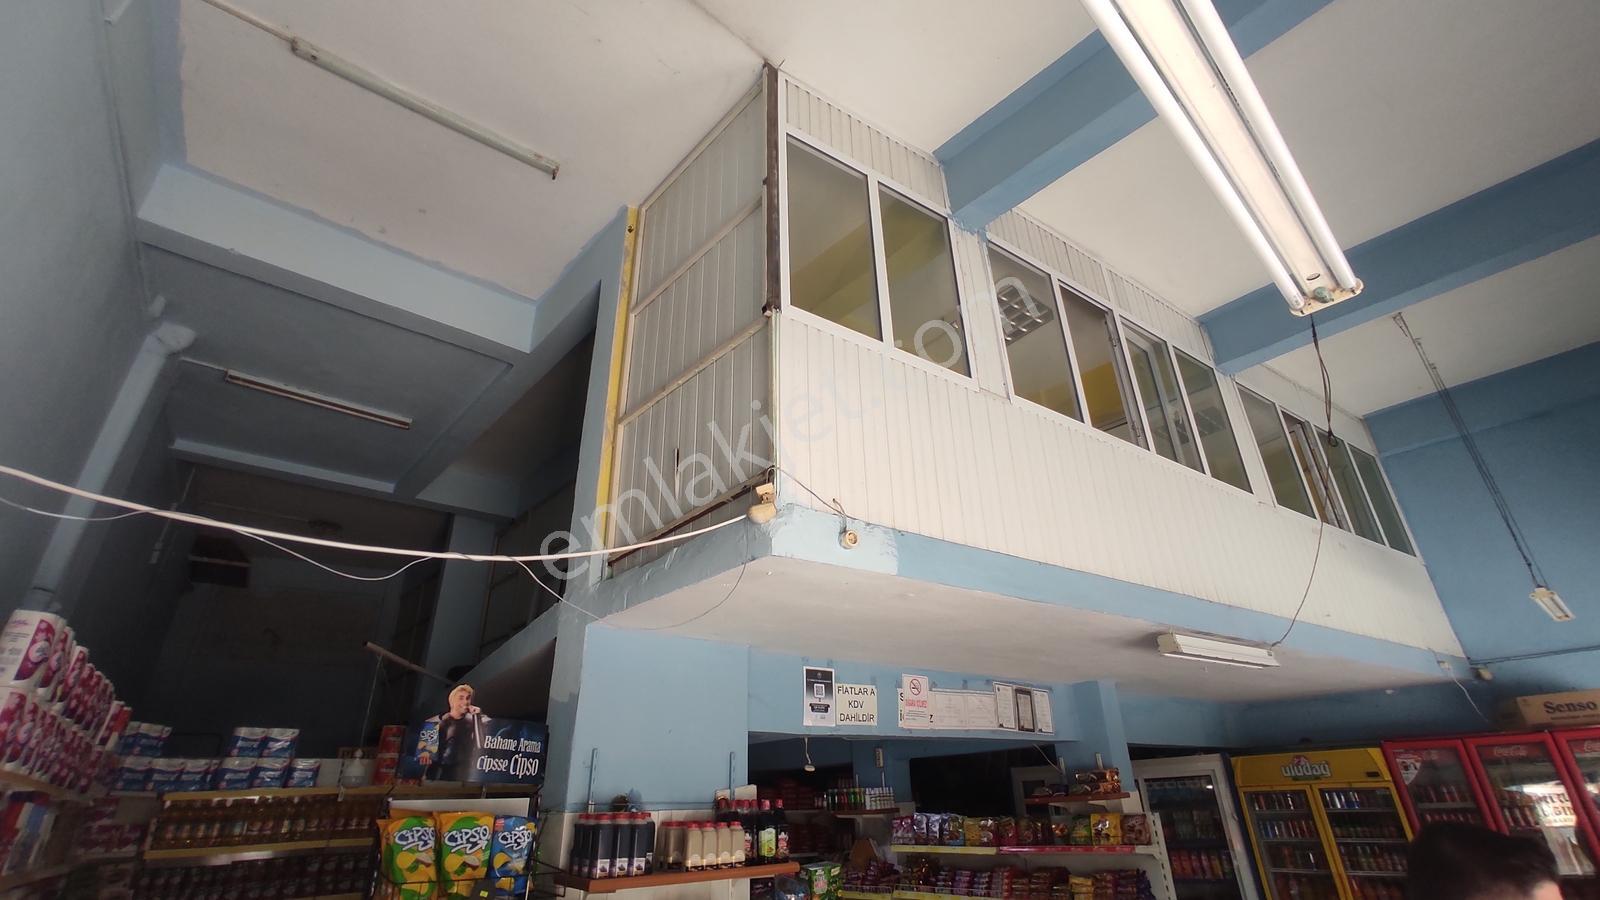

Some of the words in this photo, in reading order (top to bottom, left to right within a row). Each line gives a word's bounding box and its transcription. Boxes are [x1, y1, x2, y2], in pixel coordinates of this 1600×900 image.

[848, 700, 865, 709] KDV
[483, 735, 517, 751] Bahane
[517, 737, 541, 753] Arama
[476, 755, 508, 773] Cipsse
[509, 753, 539, 779] Cipso
